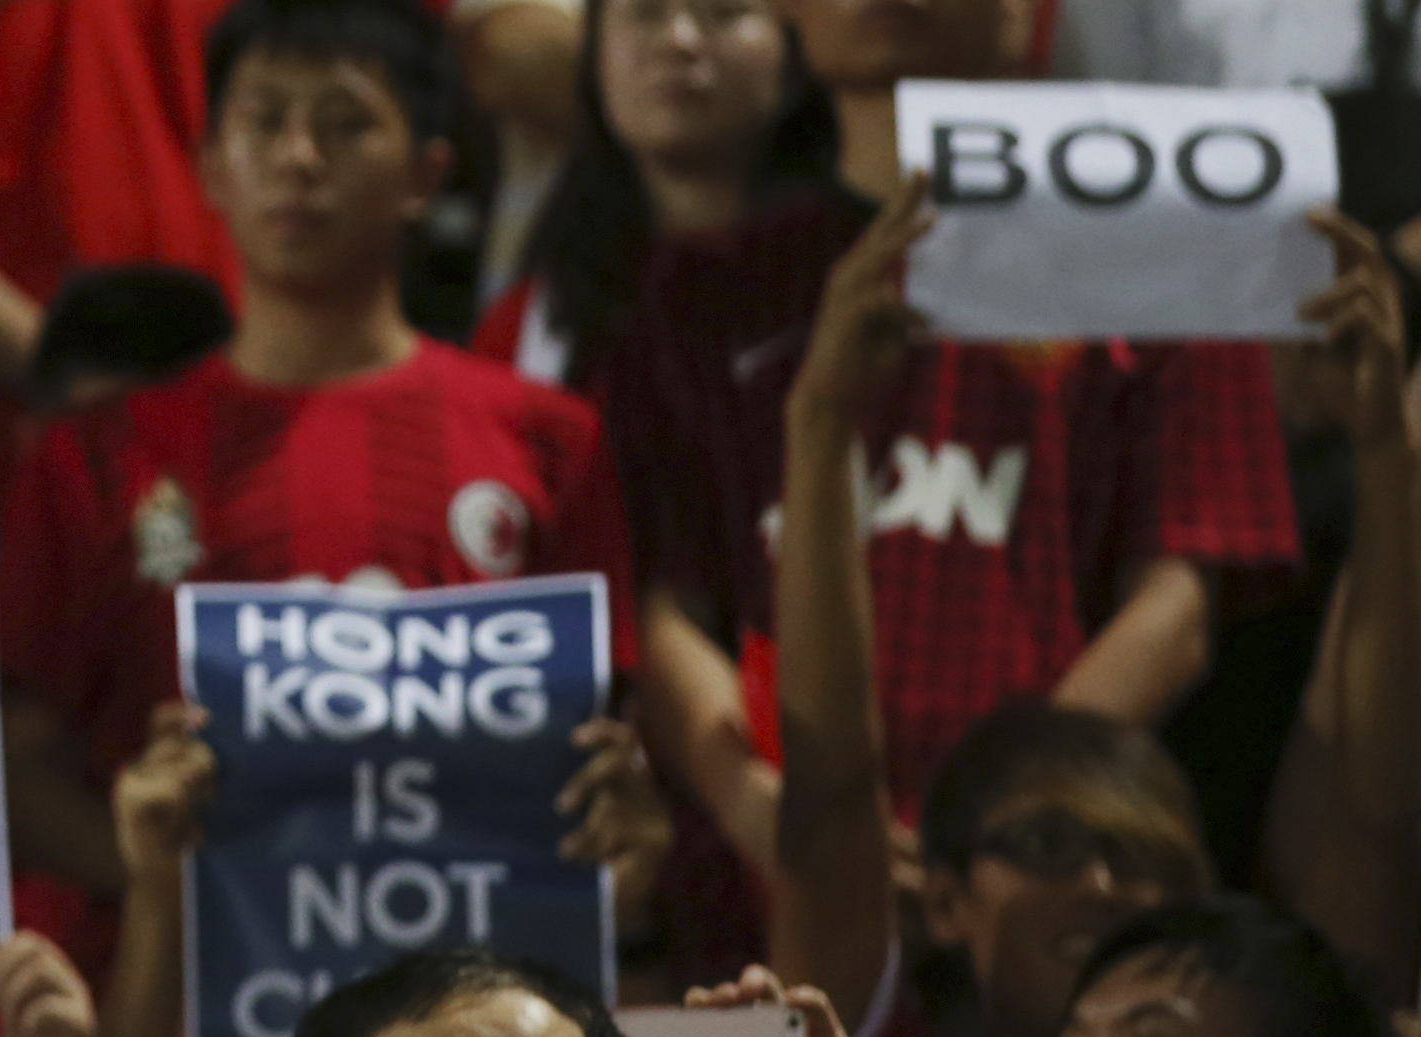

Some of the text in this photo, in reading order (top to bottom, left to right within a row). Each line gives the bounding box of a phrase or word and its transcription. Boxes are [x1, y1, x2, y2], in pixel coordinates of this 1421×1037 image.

[932, 120, 1284, 208] BOO
[236, 604, 553, 672] HONG
[242, 661, 549, 741] KONG
[352, 759, 441, 844] IS
[288, 860, 509, 949] NOT
